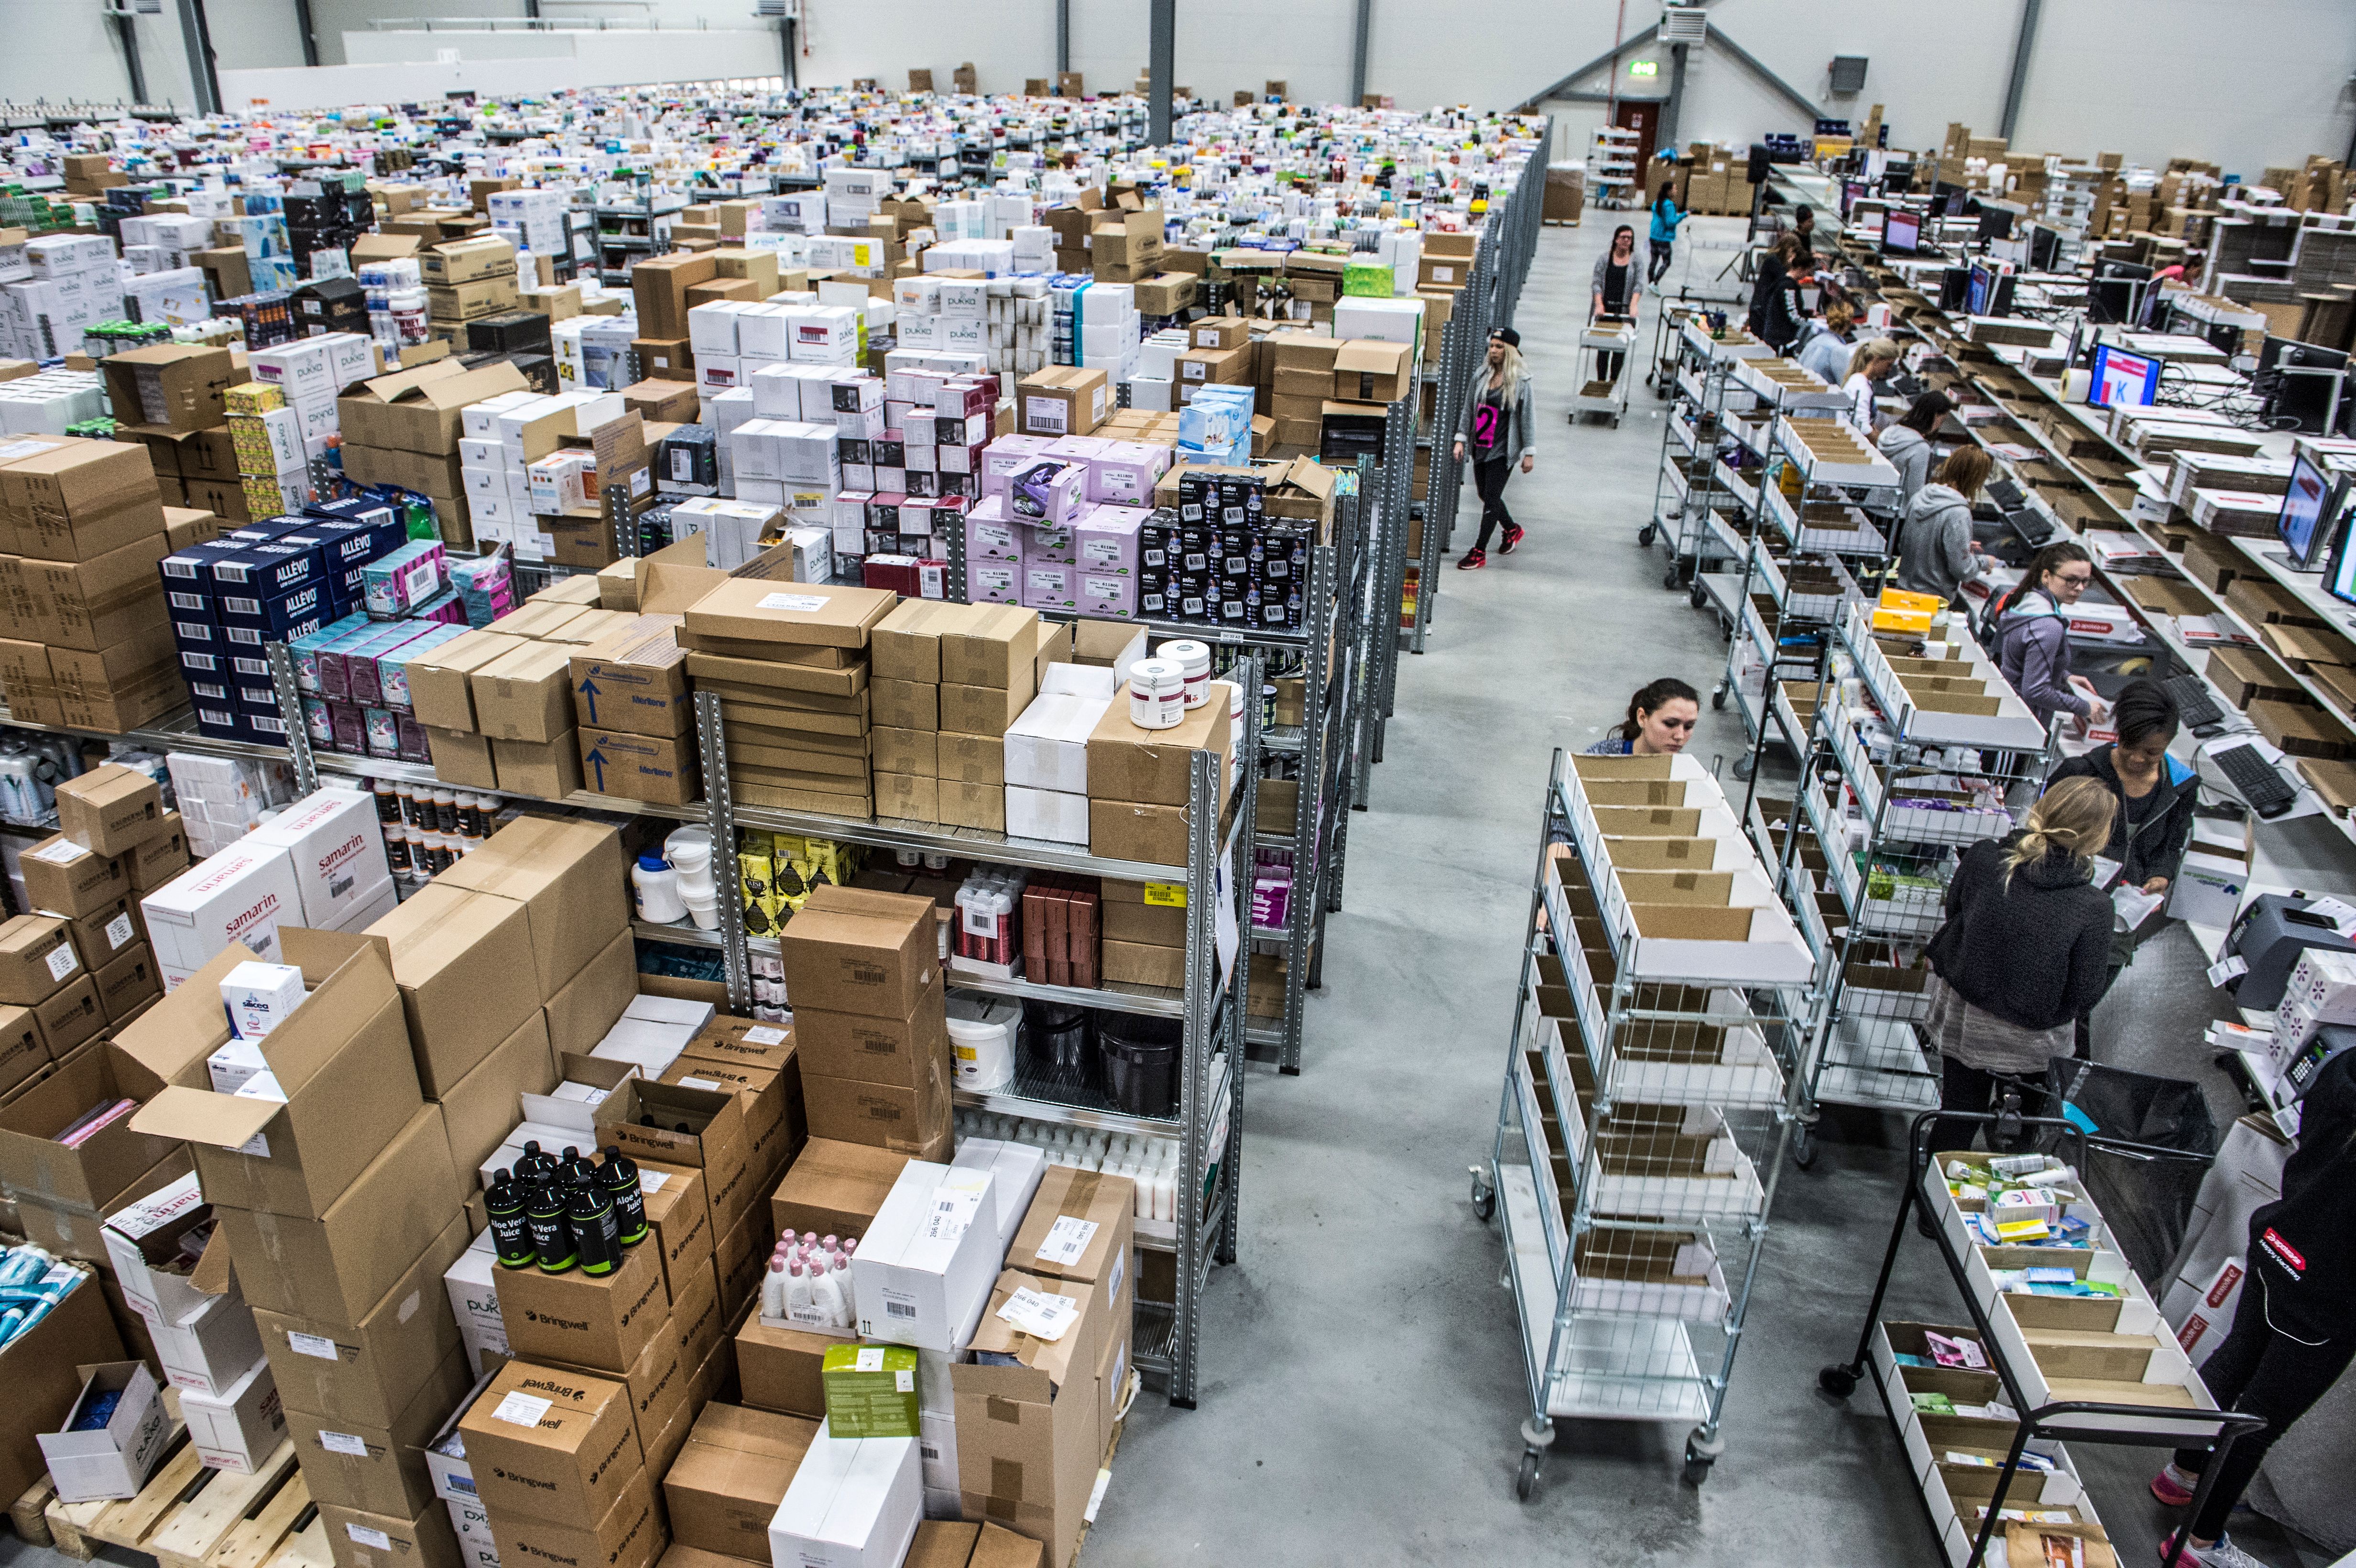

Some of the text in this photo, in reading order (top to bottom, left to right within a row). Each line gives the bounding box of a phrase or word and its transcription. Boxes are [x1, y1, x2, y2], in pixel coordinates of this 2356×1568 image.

[948, 297, 976, 306] pukka
[394, 318, 420, 328] WHEY
[400, 326, 427, 336] PROTEIN
[905, 327, 932, 336] pukka
[839, 327, 854, 340] pukka
[950, 330, 978, 339] pukka
[341, 353, 365, 367] pukka
[297, 363, 323, 378] pukka
[2116, 380, 2127, 402] K
[308, 406, 334, 423] pukka
[1476, 407, 1497, 447] 2
[278, 423, 291, 460] pukka
[341, 534, 371, 557] ALLÉVO
[810, 550, 828, 570] pukka
[276, 558, 309, 582] ALLÉVO
[286, 588, 317, 613] ALLÉVO
[288, 618, 319, 643] ALLÉVO
[632, 695, 666, 708] Meritene
[639, 765, 673, 777] Meritene
[294, 800, 342, 830] samarin
[318, 833, 363, 871] samarin
[197, 857, 253, 892] samarin
[225, 893, 278, 935] samarin
[724, 1043, 767, 1055] Bringwell
[693, 1068, 737, 1081] Bringwell
[629, 1133, 675, 1149] Bringwell
[721, 1163, 747, 1198] Bringwell
[617, 1194, 632, 1205] Aloe
[626, 1197, 642, 1212] Juice
[491, 1216, 526, 1230] Aloe Vera
[500, 1227, 520, 1237] Juice
[538, 1224, 557, 1233] Vera
[571, 1224, 584, 1235] era
[679, 1212, 705, 1252] Bringwell
[930, 1216, 941, 1238] 266 040
[1076, 1222, 1091, 1240] 266 040
[532, 1232, 549, 1241] Juice
[2258, 1239, 2301, 1281] Happy Yachting
[2273, 1239, 2301, 1265] apotea.se
[630, 1275, 659, 1316] Bringwell
[2212, 1274, 2233, 1304] apotea.se
[467, 1299, 501, 1315] puk
[1014, 1293, 1039, 1307] 266 040
[540, 1315, 589, 1331] Bringwell
[689, 1298, 715, 1338] Bringwell
[173, 1373, 205, 1386] samarin
[521, 1379, 573, 1397] Bringwell
[649, 1360, 677, 1403] Bringwell
[136, 1416, 160, 1461] pukka
[205, 1455, 240, 1466] samarin
[599, 1428, 630, 1475] Bringwell
[508, 1473, 556, 1492] Bringwell
[619, 1507, 649, 1554] Bringwell
[530, 1546, 577, 1566] Bringwell
